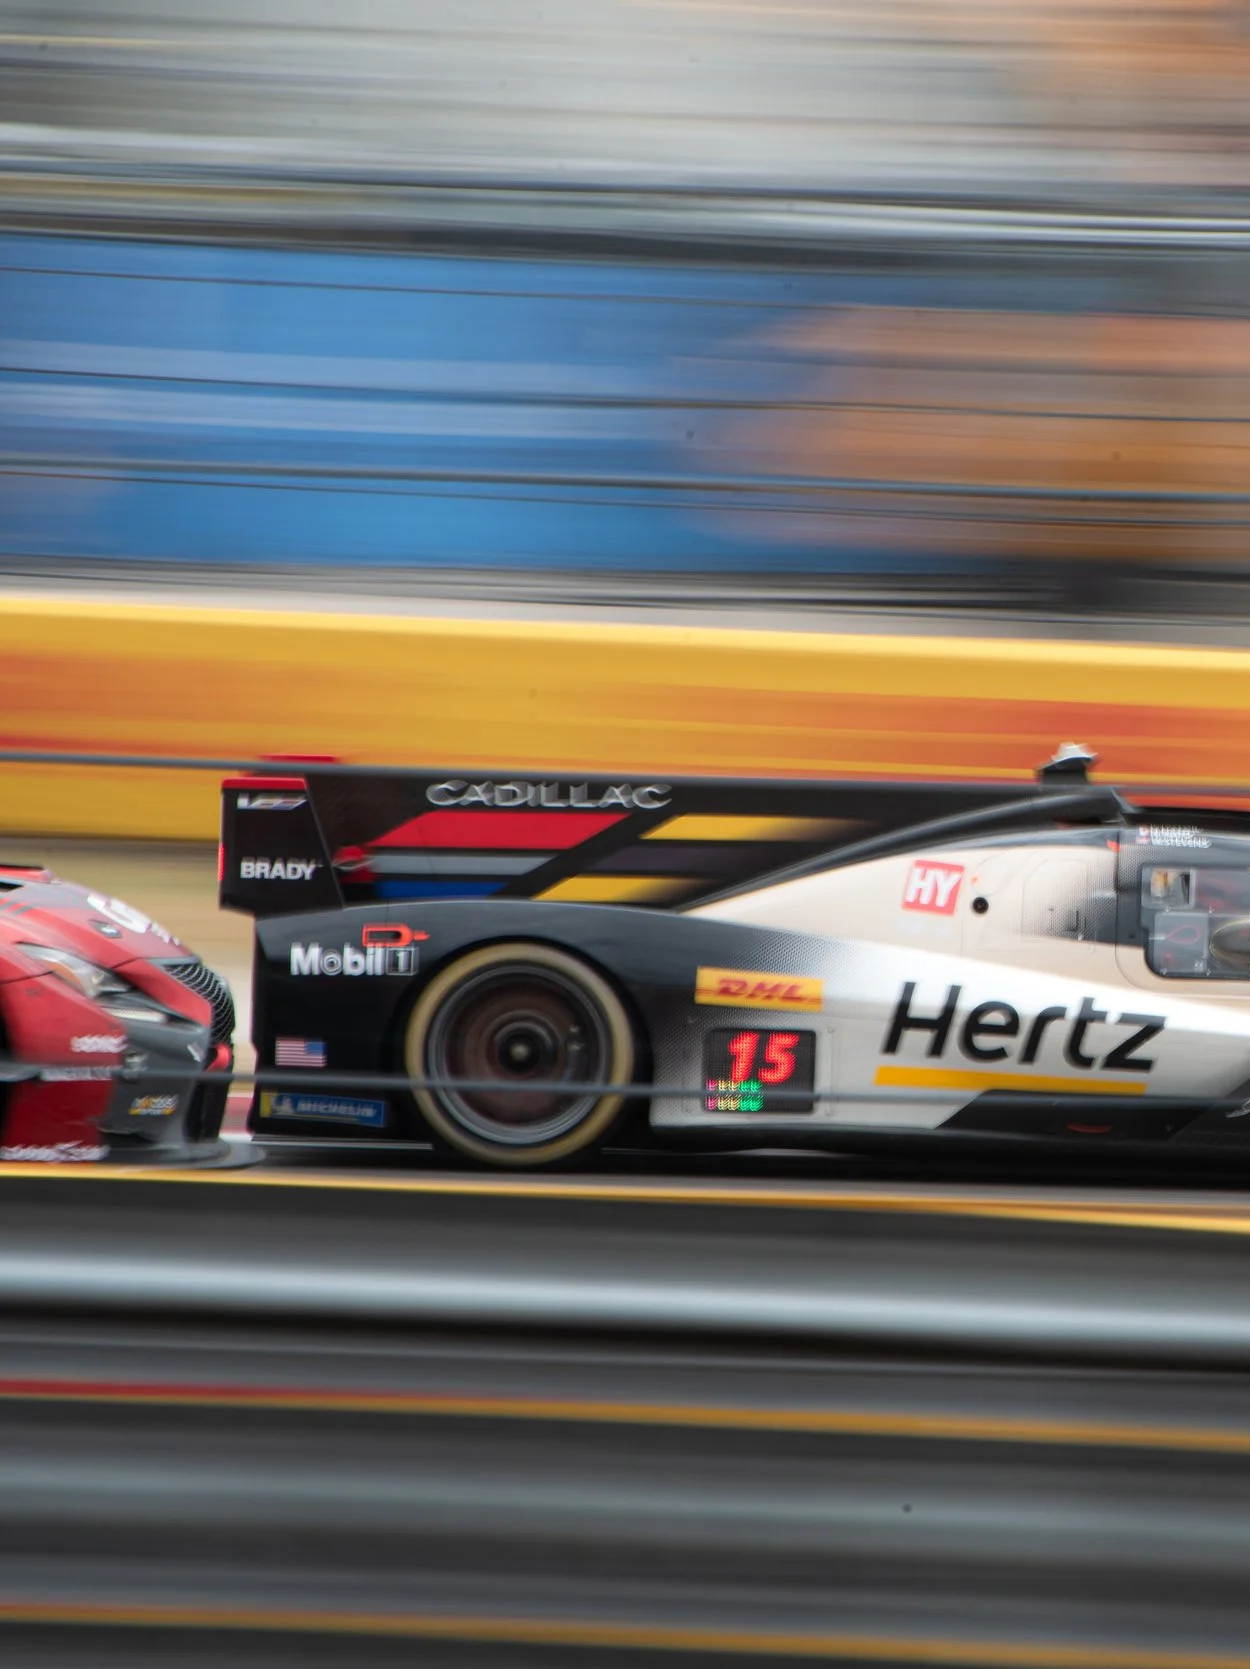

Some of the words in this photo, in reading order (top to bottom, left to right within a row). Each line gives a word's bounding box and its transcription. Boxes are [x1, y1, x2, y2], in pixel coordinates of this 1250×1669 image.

[426, 779, 672, 809] CADILLAC
[240, 857, 316, 880] BRADY
[905, 866, 963, 908] HY
[717, 979, 806, 1003] DHL
[880, 981, 1169, 1073] Hertz
[728, 1031, 801, 1085] 15
